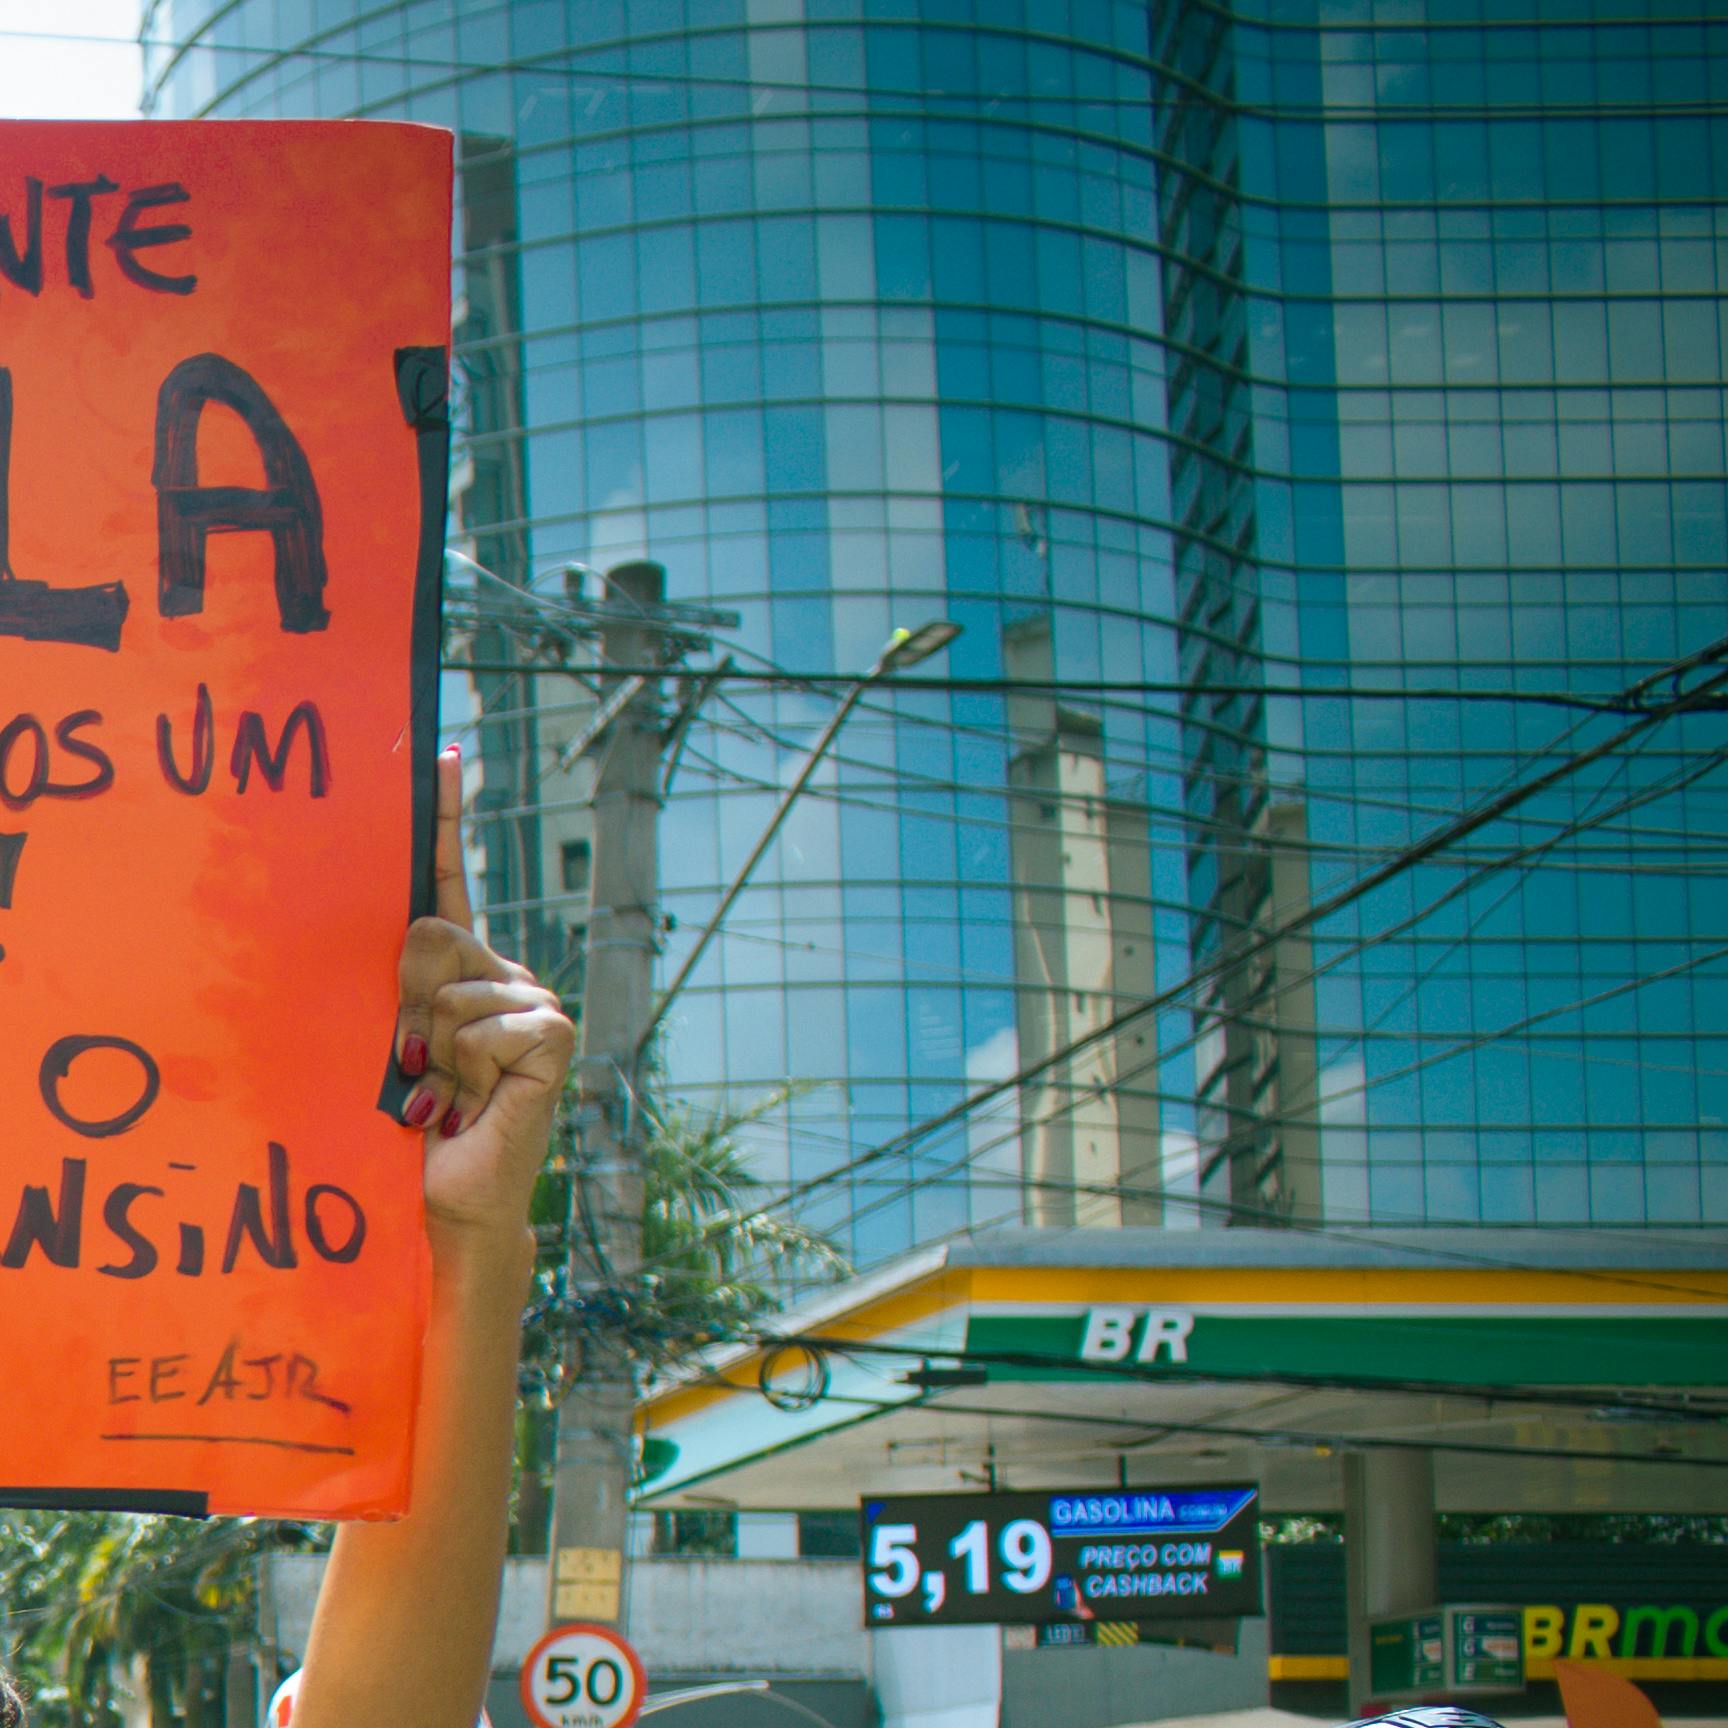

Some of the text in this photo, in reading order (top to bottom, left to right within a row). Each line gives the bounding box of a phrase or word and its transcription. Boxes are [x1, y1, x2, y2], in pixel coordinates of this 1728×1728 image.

[156, 682, 333, 797] UM
[38, 1033, 161, 1138] O
[1079, 1308, 1195, 1363] BR
[1055, 1497, 1175, 1523] GASOLINA
[868, 1519, 1053, 1613] 5,19
[1080, 1541, 1212, 1571] PREÇO COM
[1085, 1571, 1209, 1597] CASHBACK
[544, 1655, 623, 1707] 50
[559, 1713, 604, 1728] km/h
